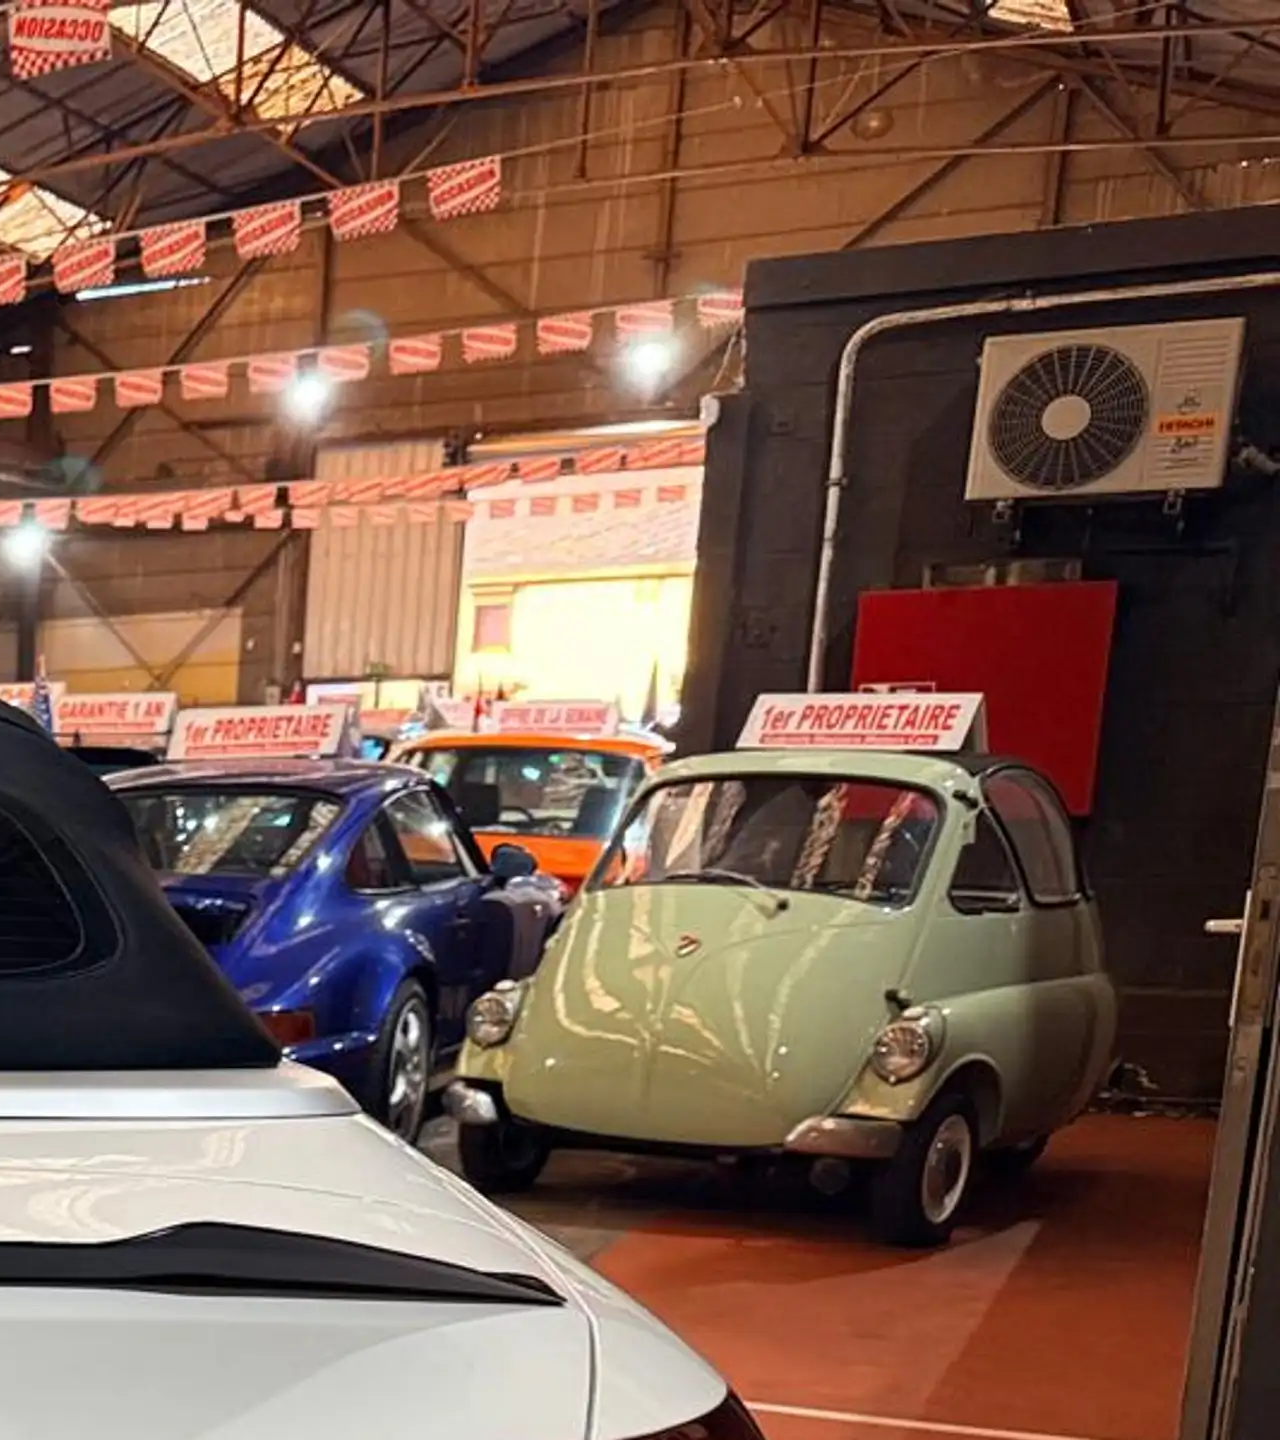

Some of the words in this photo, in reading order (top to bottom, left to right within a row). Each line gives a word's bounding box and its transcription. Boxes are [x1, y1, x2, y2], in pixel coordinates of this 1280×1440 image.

[59, 700, 129, 720] GARANTIE
[761, 706, 796, 730] 1er
[796, 704, 960, 730] PROPRIETAIRE
[211, 713, 334, 741] PROPRIETAIRE
